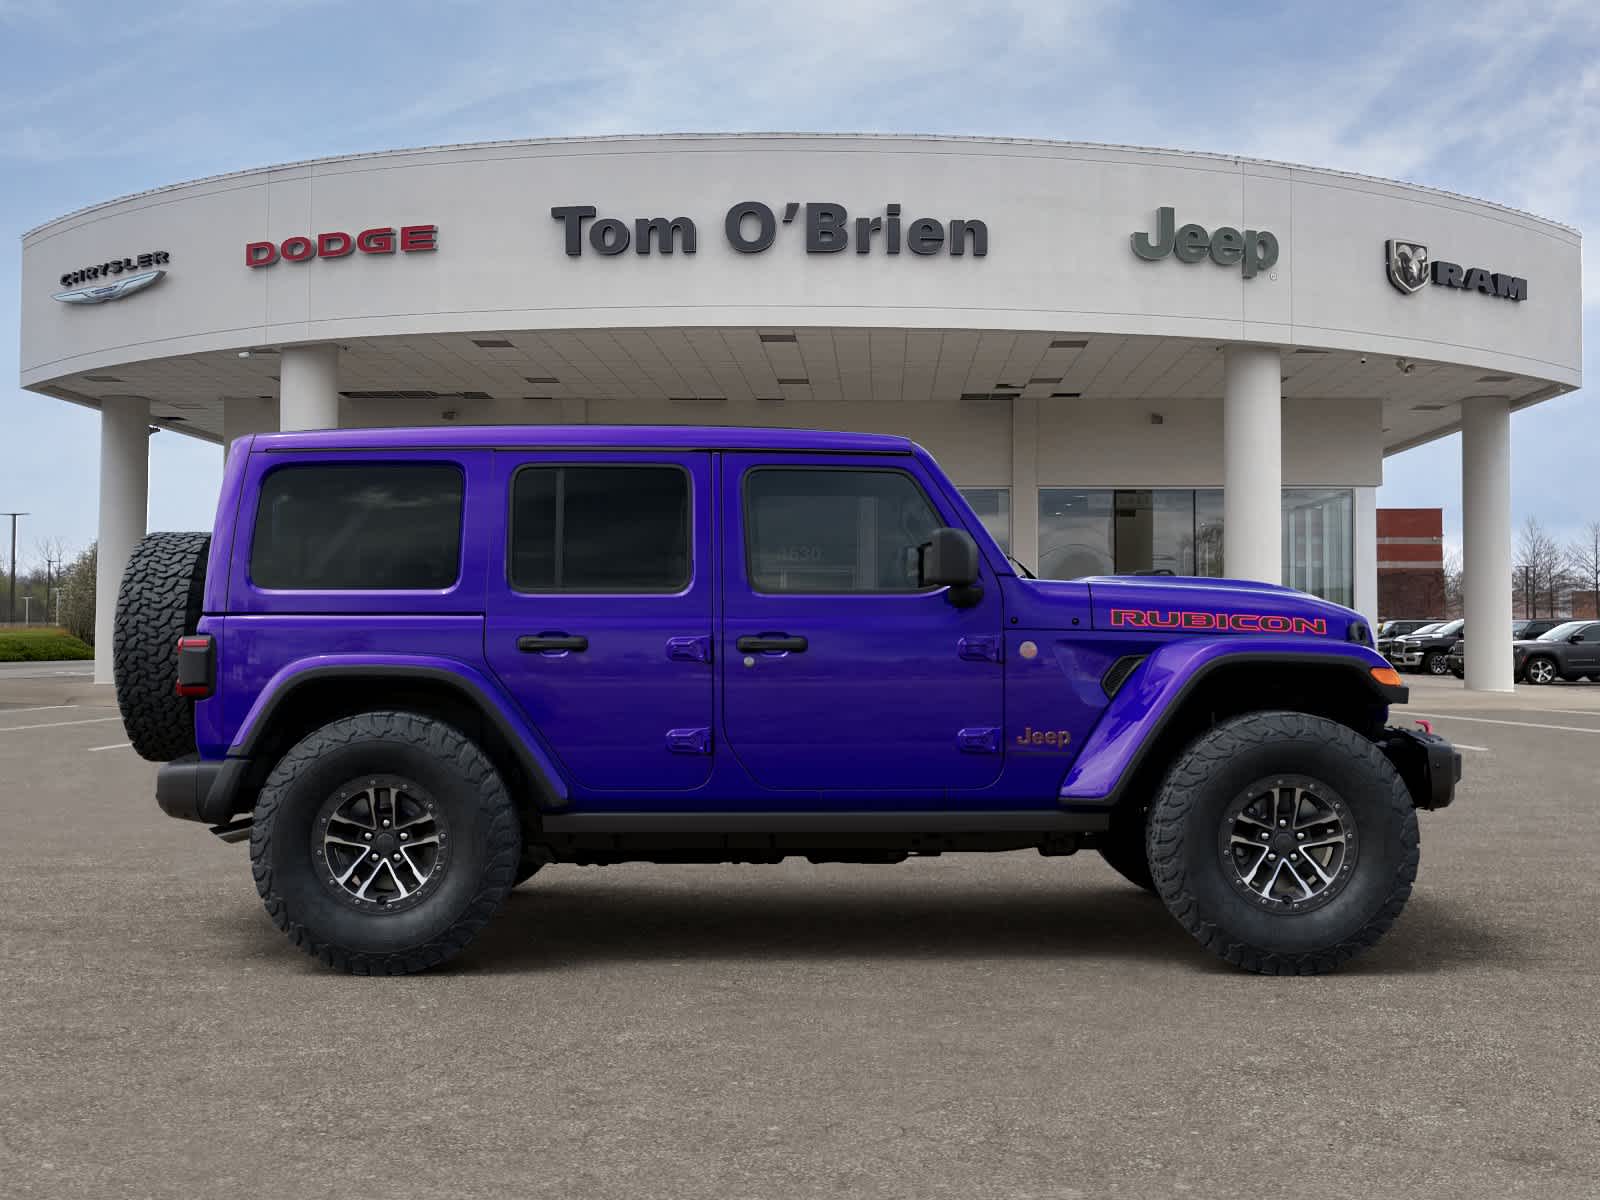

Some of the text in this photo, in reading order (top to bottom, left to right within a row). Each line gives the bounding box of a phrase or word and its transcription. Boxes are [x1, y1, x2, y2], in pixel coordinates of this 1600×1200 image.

[245, 225, 438, 269] DODGE
[551, 201, 989, 257] Tom O'Brien
[1130, 206, 1279, 279] Jeep
[60, 250, 170, 287] CHRYSLER
[1431, 260, 1528, 301] RAM
[1110, 608, 1328, 635] RUBICON
[1016, 727, 1072, 750] Jeep
